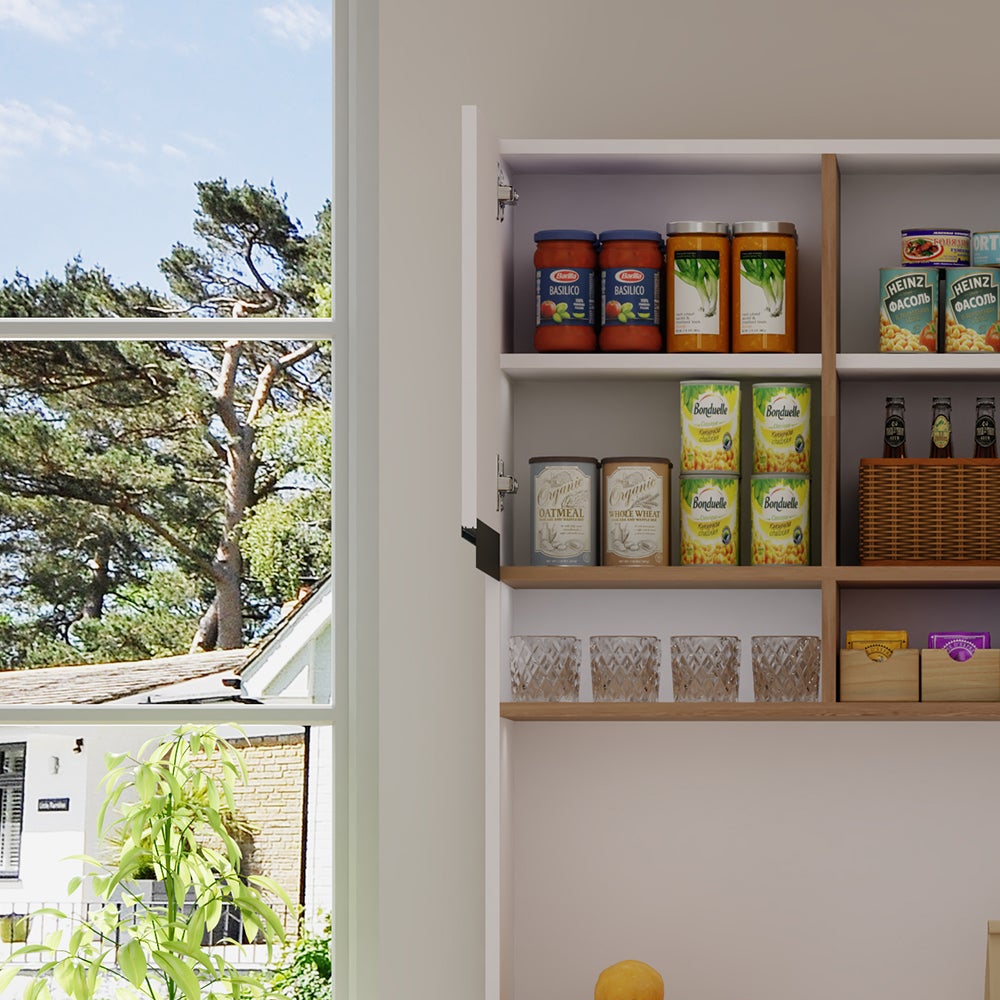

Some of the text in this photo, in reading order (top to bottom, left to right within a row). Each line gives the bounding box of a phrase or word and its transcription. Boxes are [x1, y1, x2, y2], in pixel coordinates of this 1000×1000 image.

[549, 285, 580, 296] BASILICO
[614, 285, 645, 296] BASILICO
[888, 276, 924, 296] HEINZ
[954, 276, 990, 296] HEINZ
[889, 293, 931, 313] ФАСОЛЬ
[954, 293, 997, 313] ФАСОЛЬ
[693, 402, 728, 418] Bonduelle
[766, 404, 801, 420] Bonduelle
[537, 476, 582, 506] Organic
[609, 476, 656, 506] Organic
[692, 496, 727, 511] Bonduelle
[763, 496, 799, 511] Bonduelle
[538, 508, 585, 518] OATMEAL
[609, 510, 661, 518] WHOLE WHEAT
